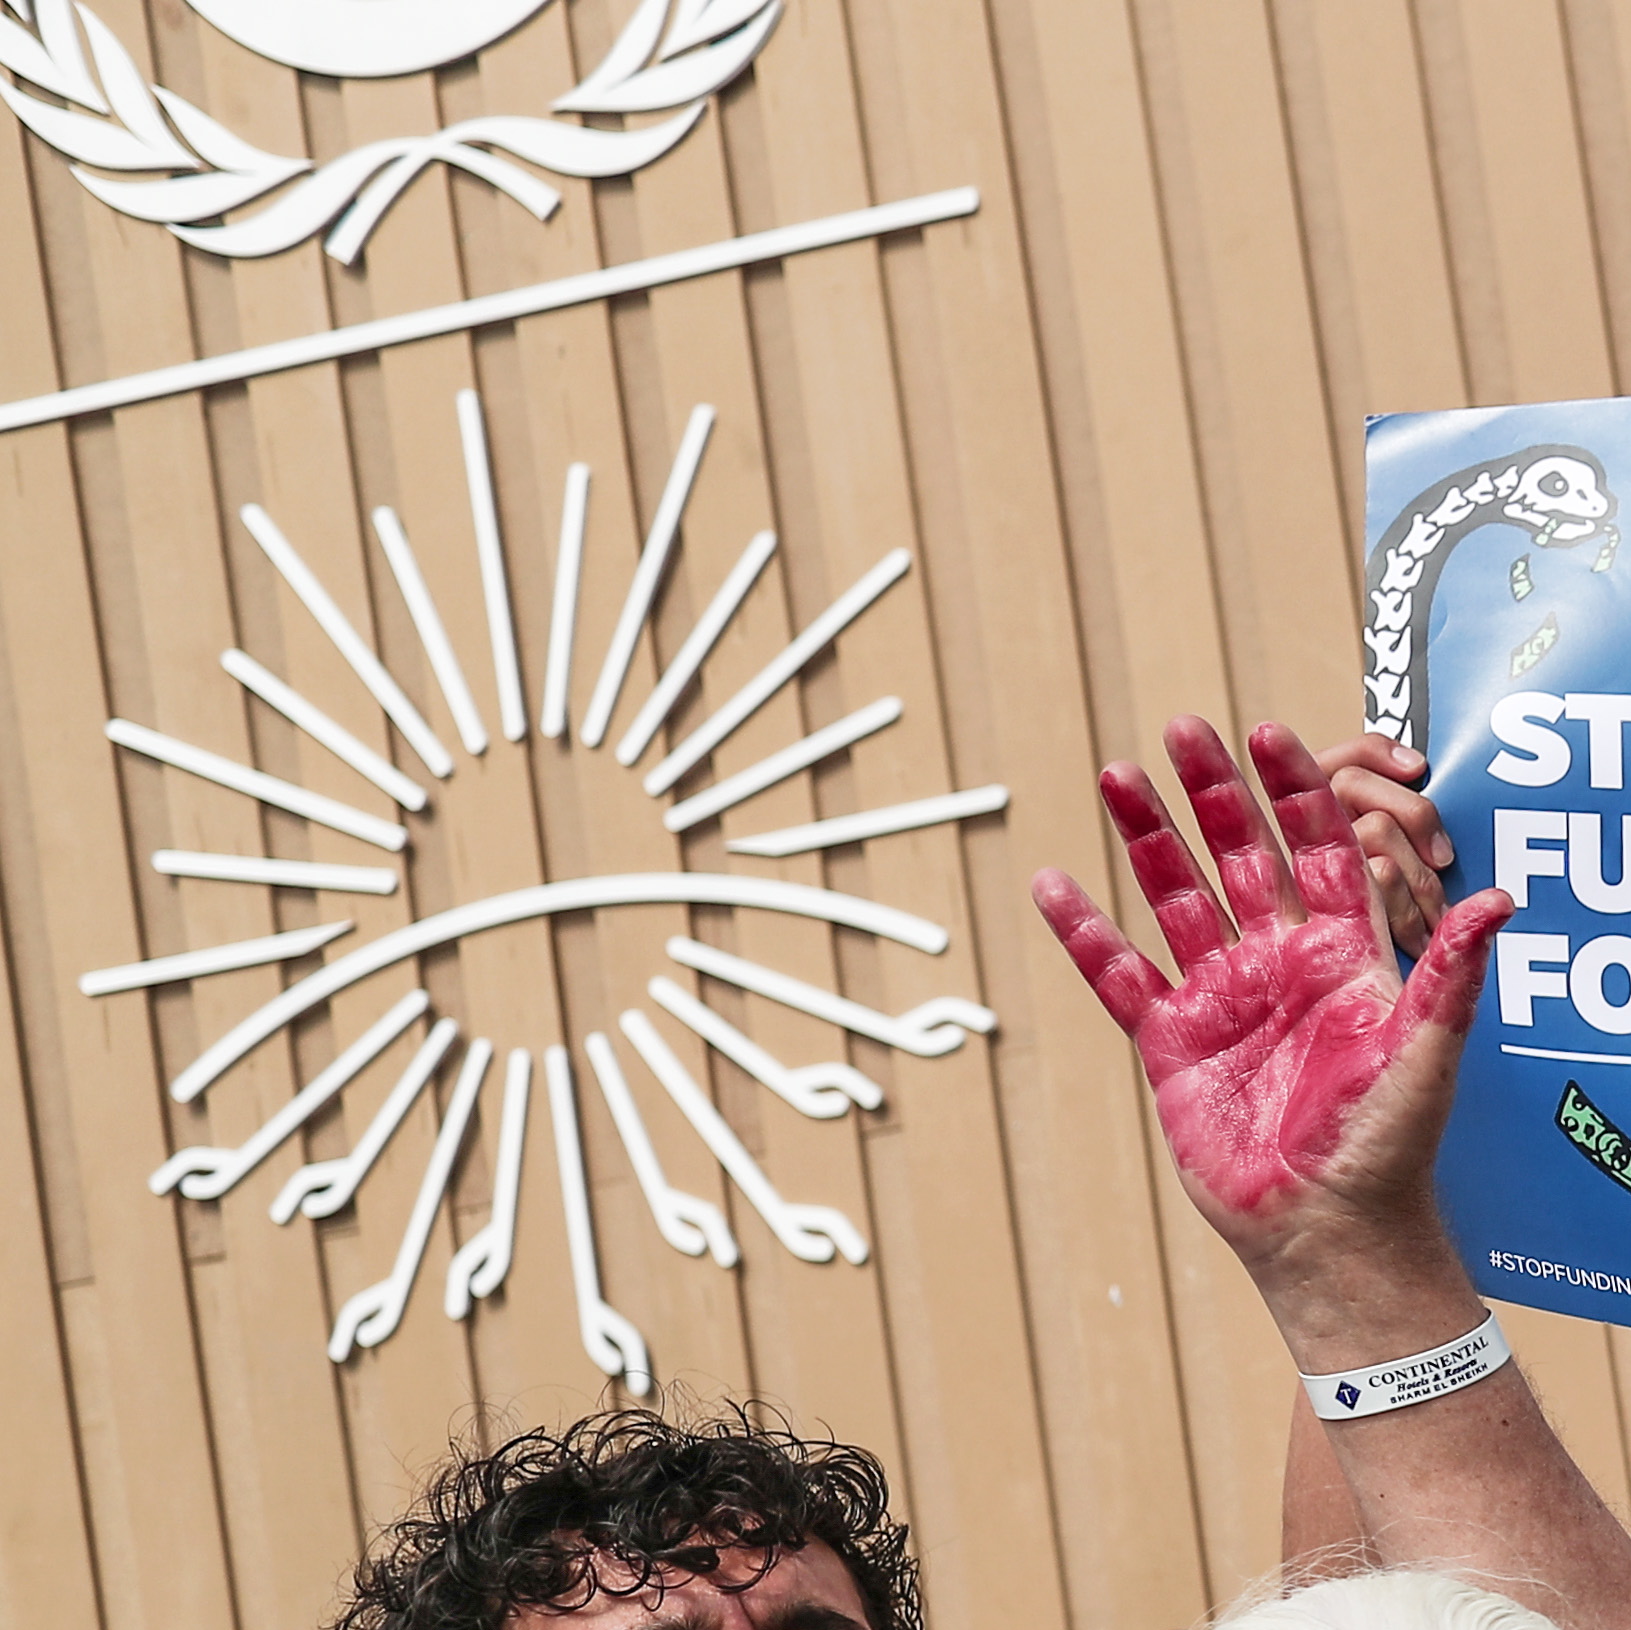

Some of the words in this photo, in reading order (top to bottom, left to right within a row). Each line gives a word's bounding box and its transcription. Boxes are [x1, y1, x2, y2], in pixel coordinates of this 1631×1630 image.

[1368, 1336, 1489, 1388] CONTINENTAL
[1390, 1387, 1431, 1404] SHARM
[1434, 1382, 1449, 1393] EL
[1451, 1362, 1489, 1386] SHEIKH
[1396, 1376, 1430, 1393] Hotels
[1444, 1358, 1479, 1381] Resorts
